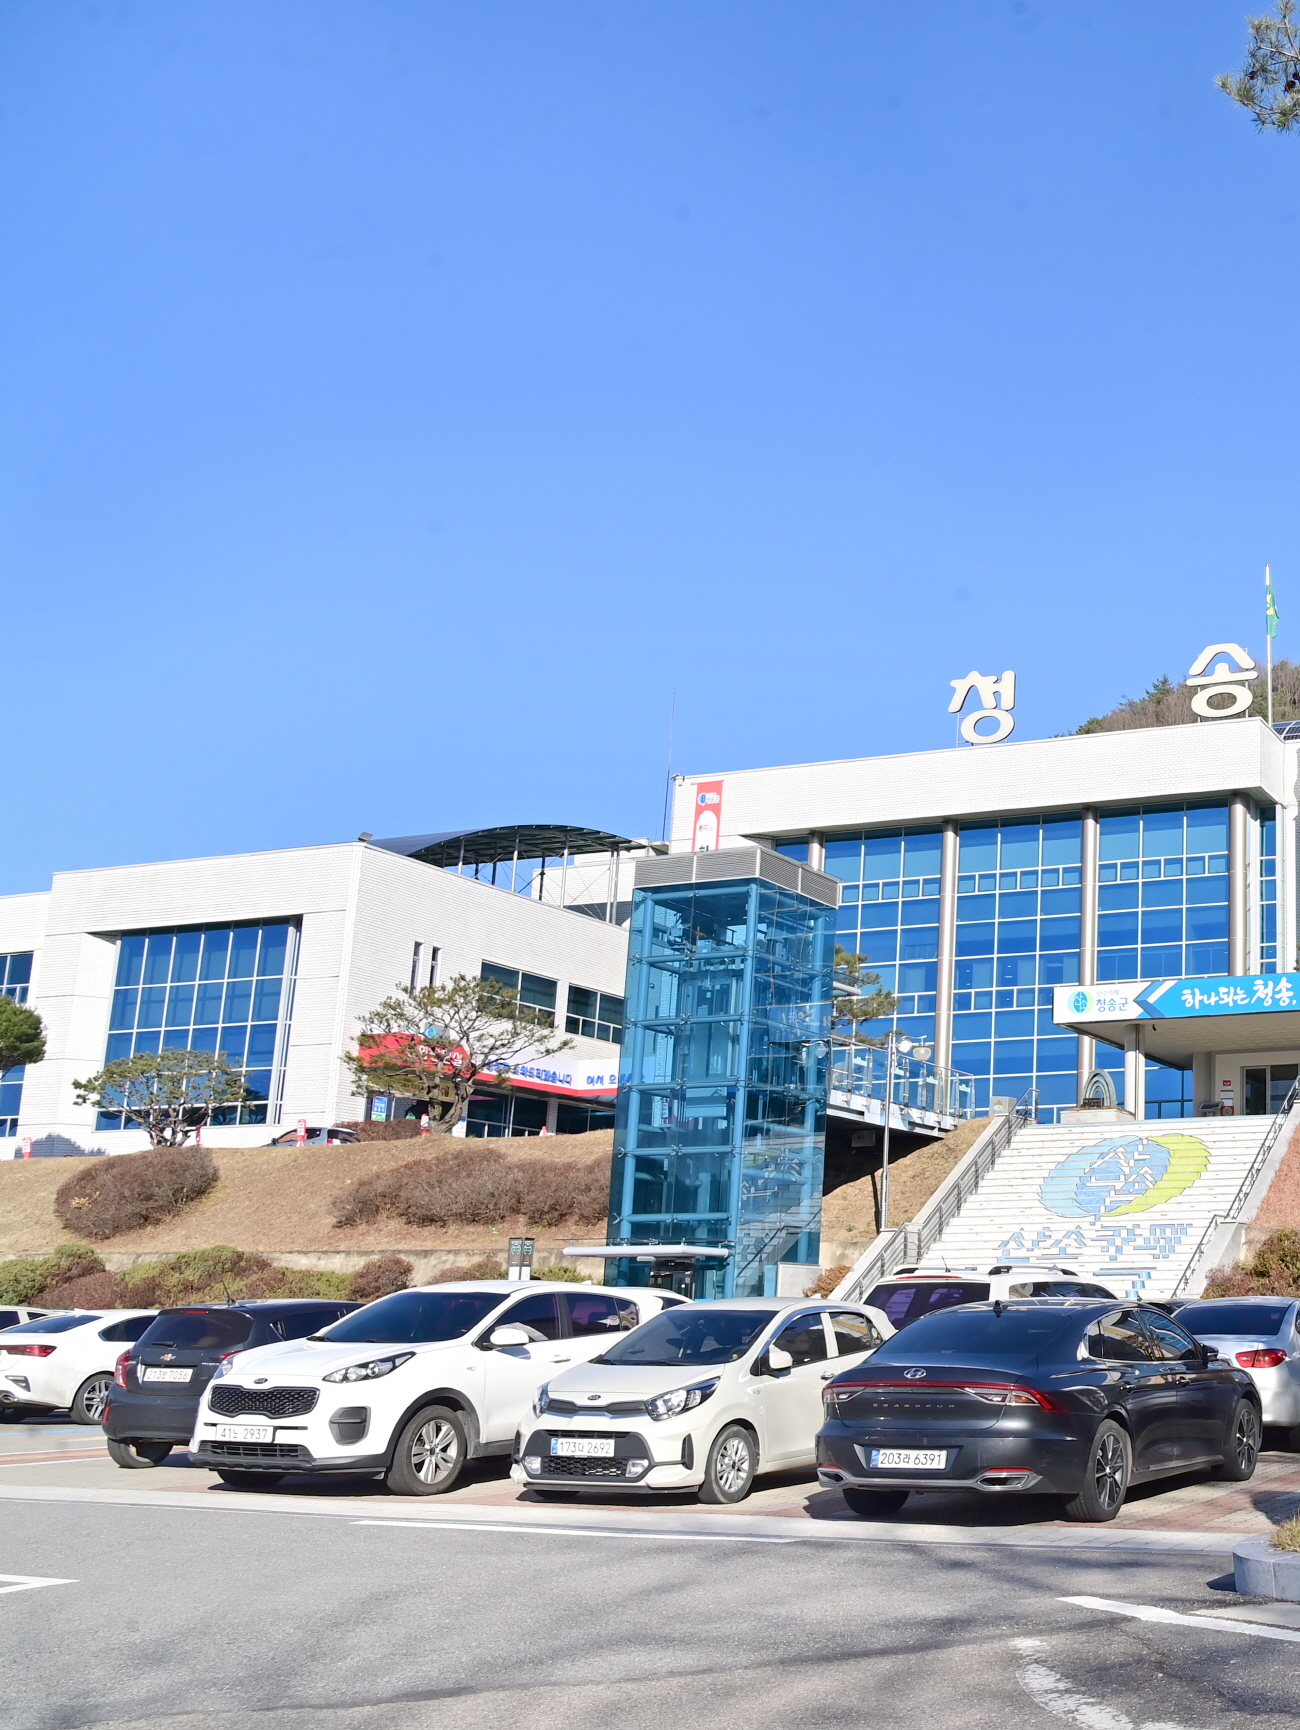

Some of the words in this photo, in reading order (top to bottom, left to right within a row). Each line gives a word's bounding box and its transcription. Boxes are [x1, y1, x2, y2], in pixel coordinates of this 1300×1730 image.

[1181, 985, 1250, 1010] 하나되는
[1251, 977, 1297, 1007] 청송,
[1095, 997, 1129, 1012] 청송군
[243, 1428, 268, 1440] 2937
[587, 1442, 611, 1454] 2692
[880, 1452, 911, 1465] 203라
[913, 1453, 942, 1466] 6391
